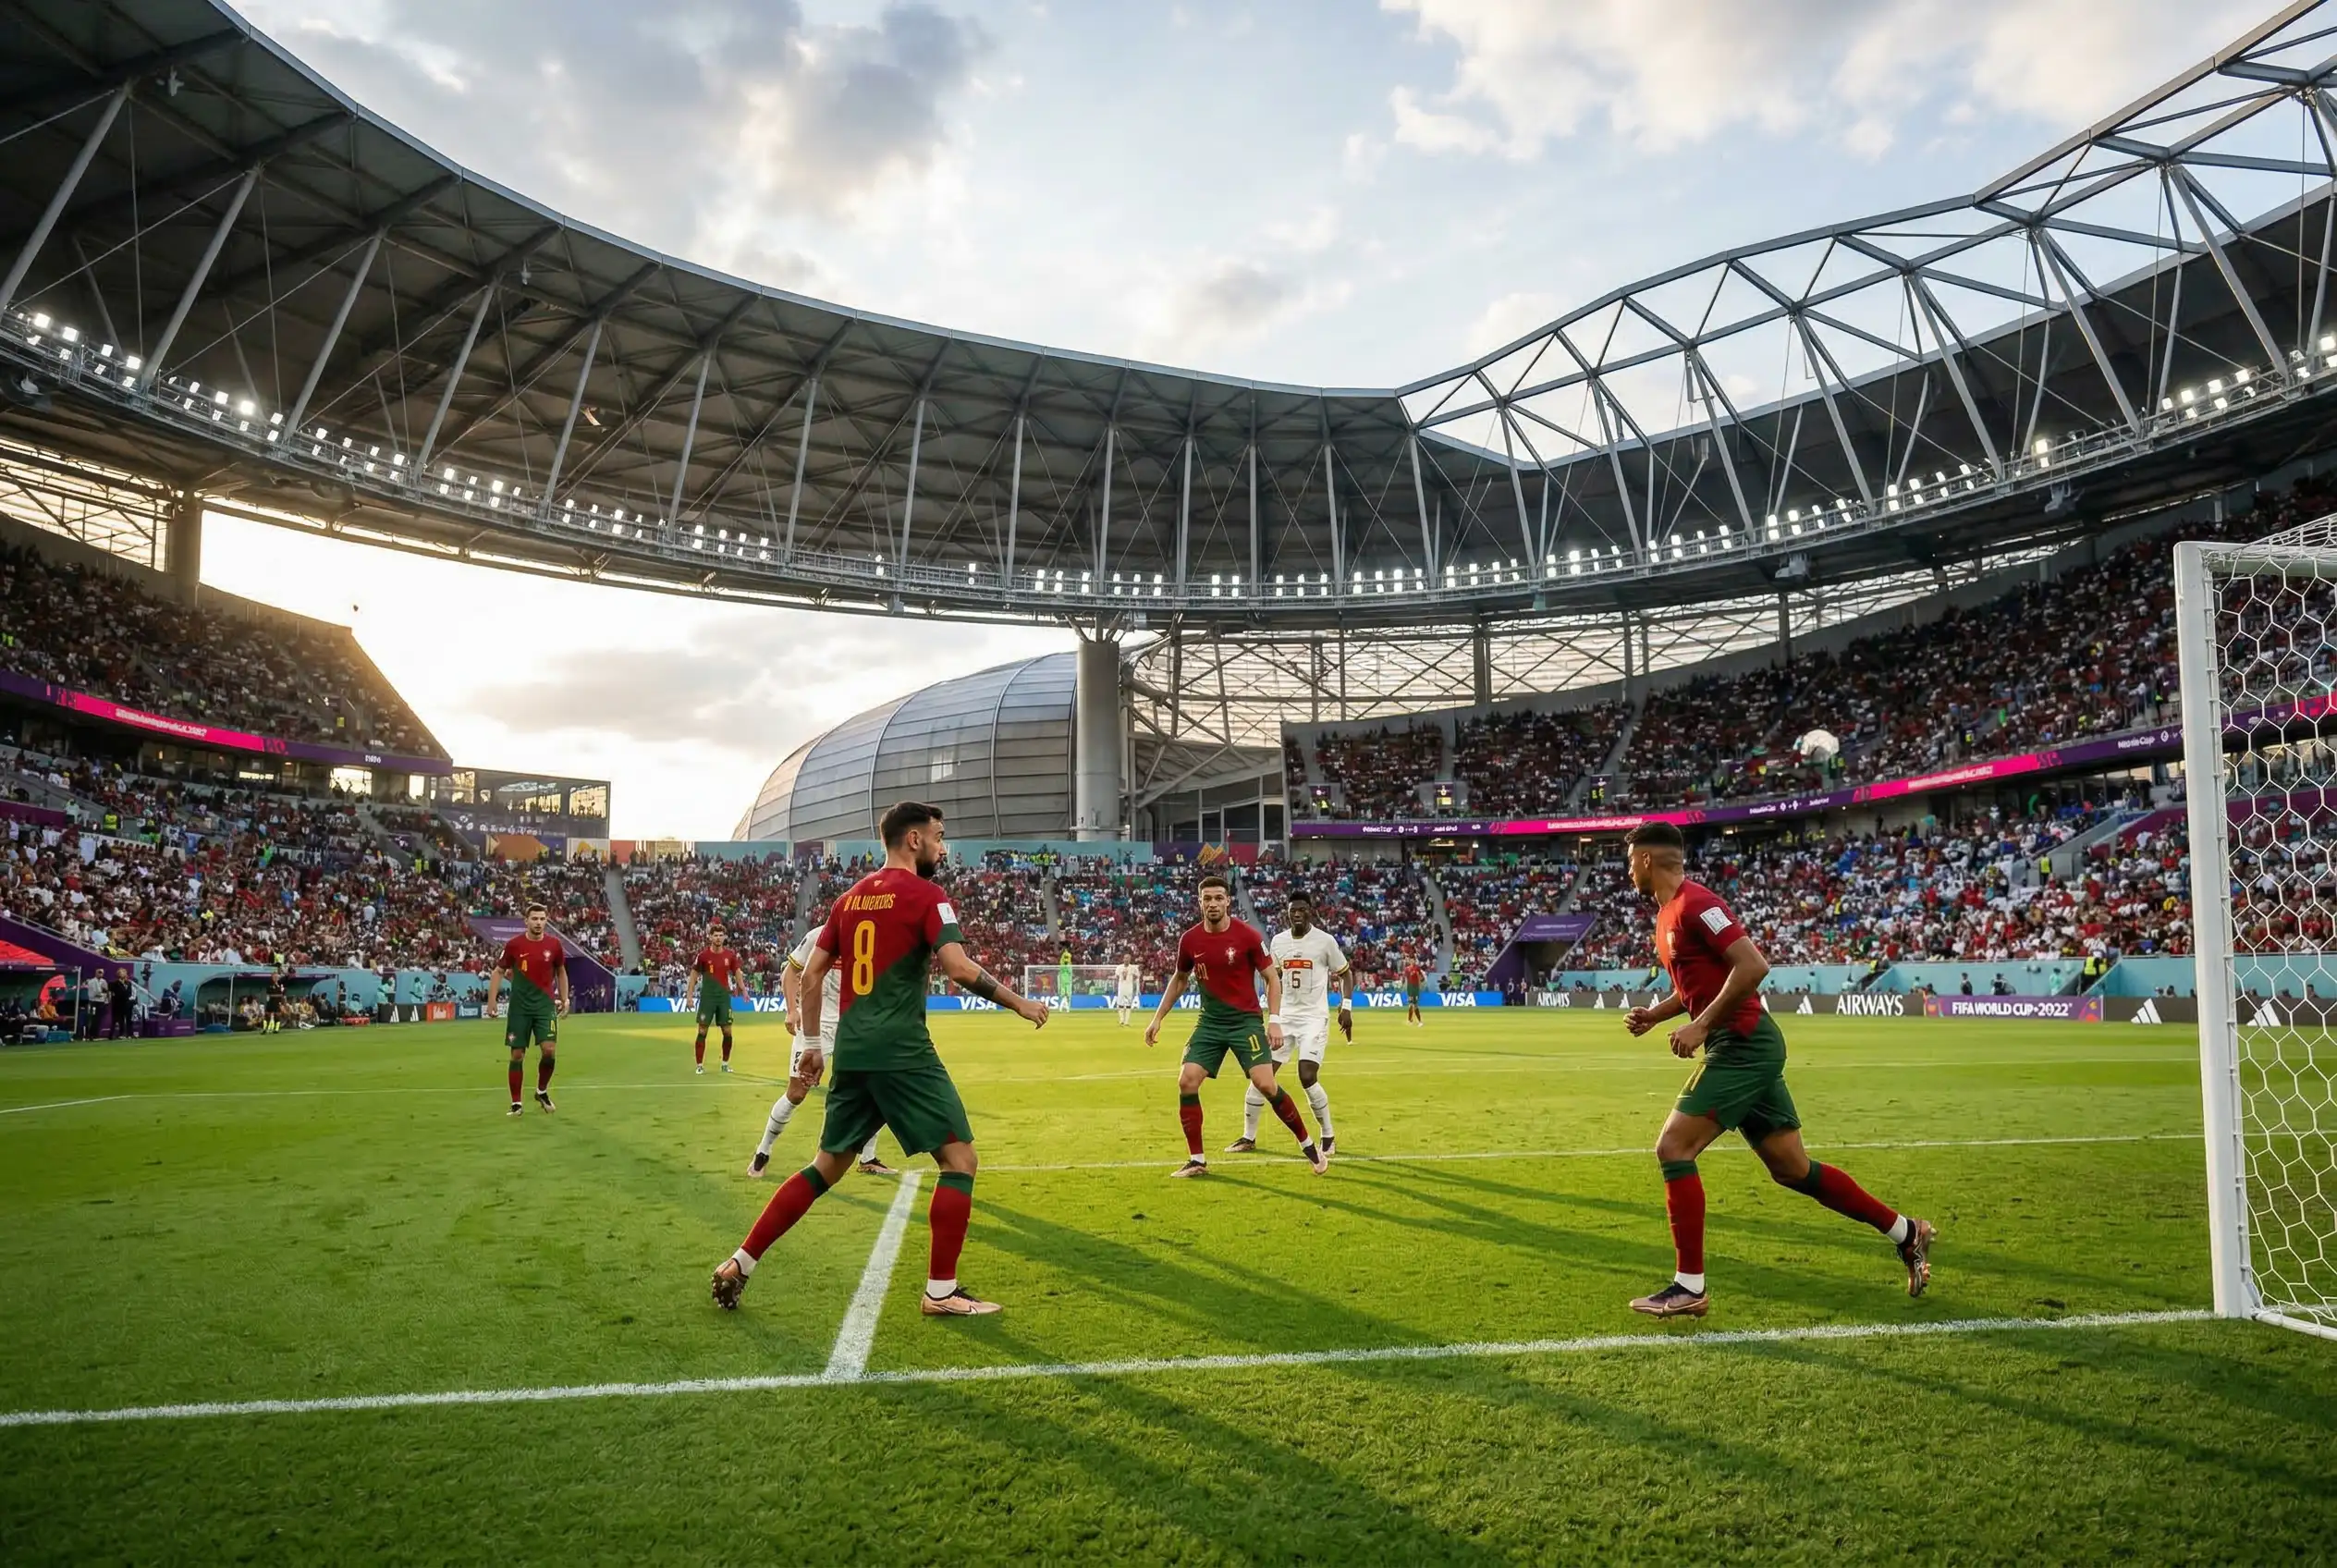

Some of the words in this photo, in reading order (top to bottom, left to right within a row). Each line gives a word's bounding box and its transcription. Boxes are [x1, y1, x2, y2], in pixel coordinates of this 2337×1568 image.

[852, 920, 875, 996] 8
[955, 996, 997, 1011] VISA
[1102, 995, 1140, 1010] VA
[1364, 993, 1403, 1007] VISA
[1437, 993, 1476, 1007] VISA
[1836, 994, 1904, 1016] AIRWAYS
[1952, 1001, 1975, 1014] FIFA
[1975, 1002, 2012, 1015] WORLD
